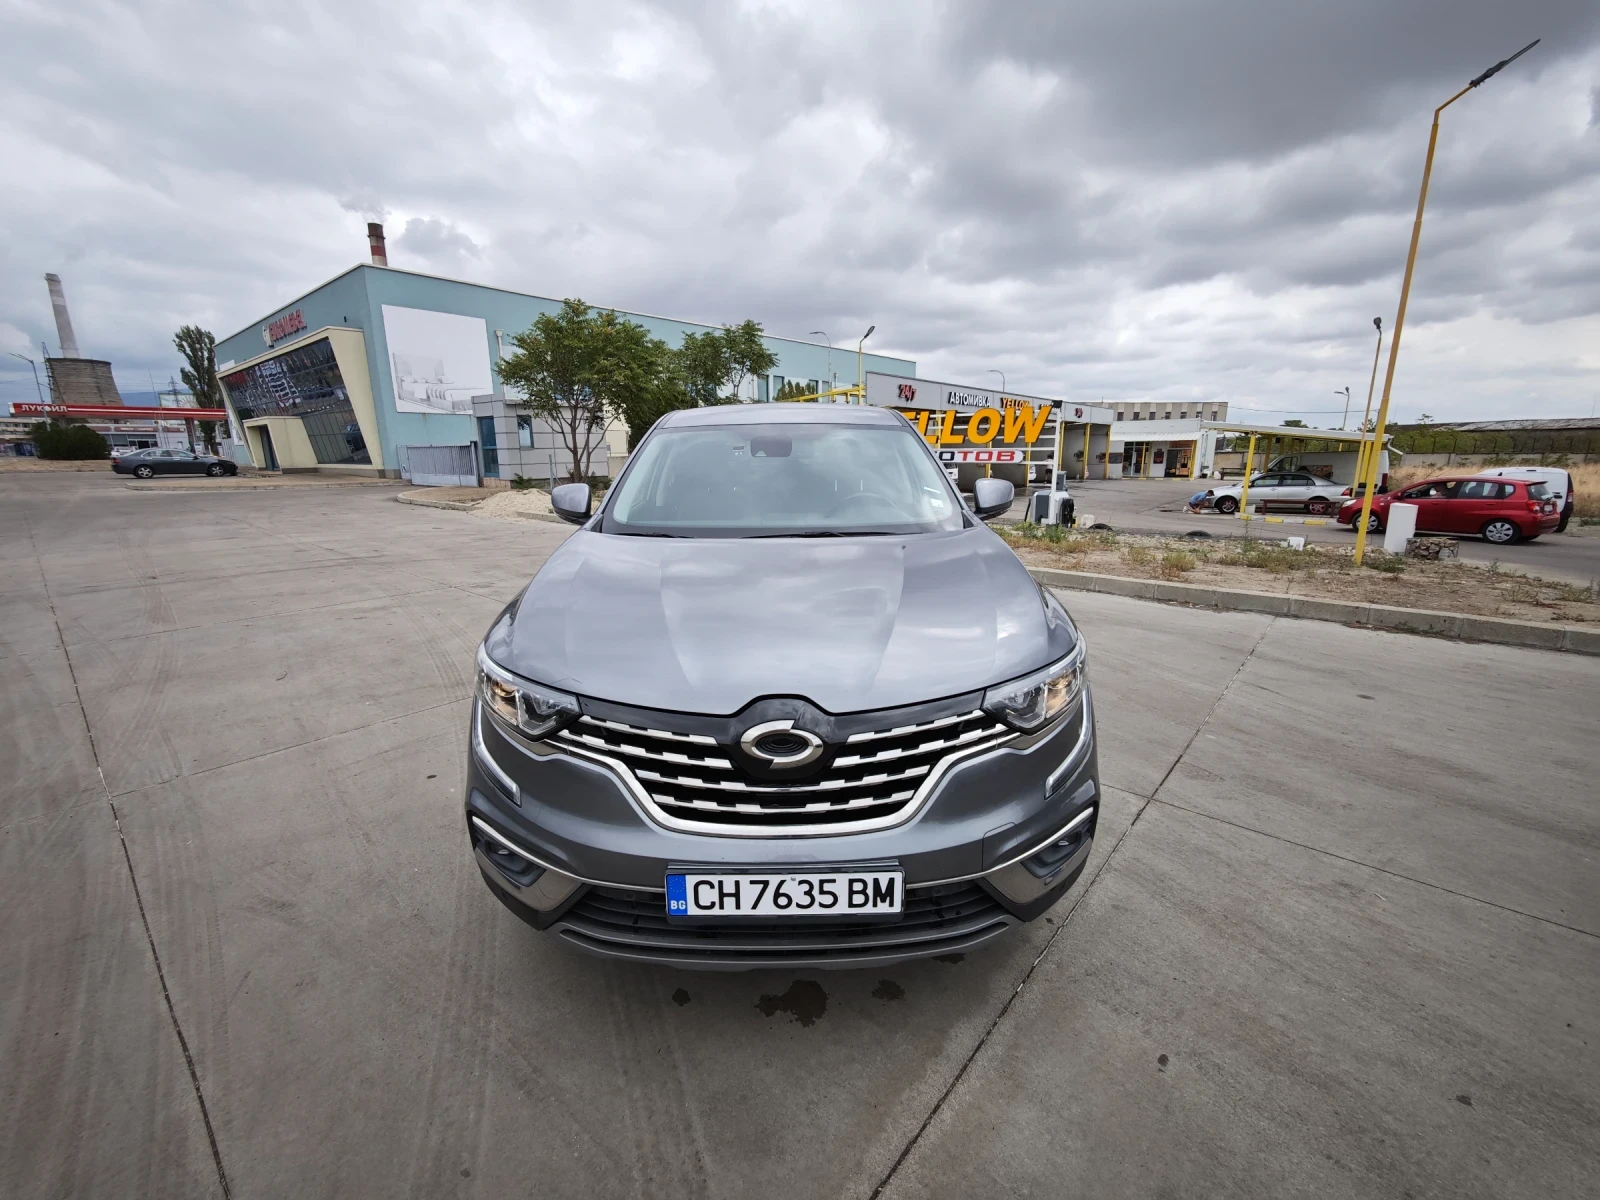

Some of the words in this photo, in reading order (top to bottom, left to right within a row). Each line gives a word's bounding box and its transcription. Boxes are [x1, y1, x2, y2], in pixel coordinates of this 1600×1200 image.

[899, 384, 917, 401] 24/7
[949, 391, 991, 407] АВТОМИВКА
[902, 405, 1053, 444] LLOW
[693, 879, 741, 911] CH
[749, 878, 839, 911] 7635
[848, 877, 895, 909] BM
[670, 900, 686, 910] BG
